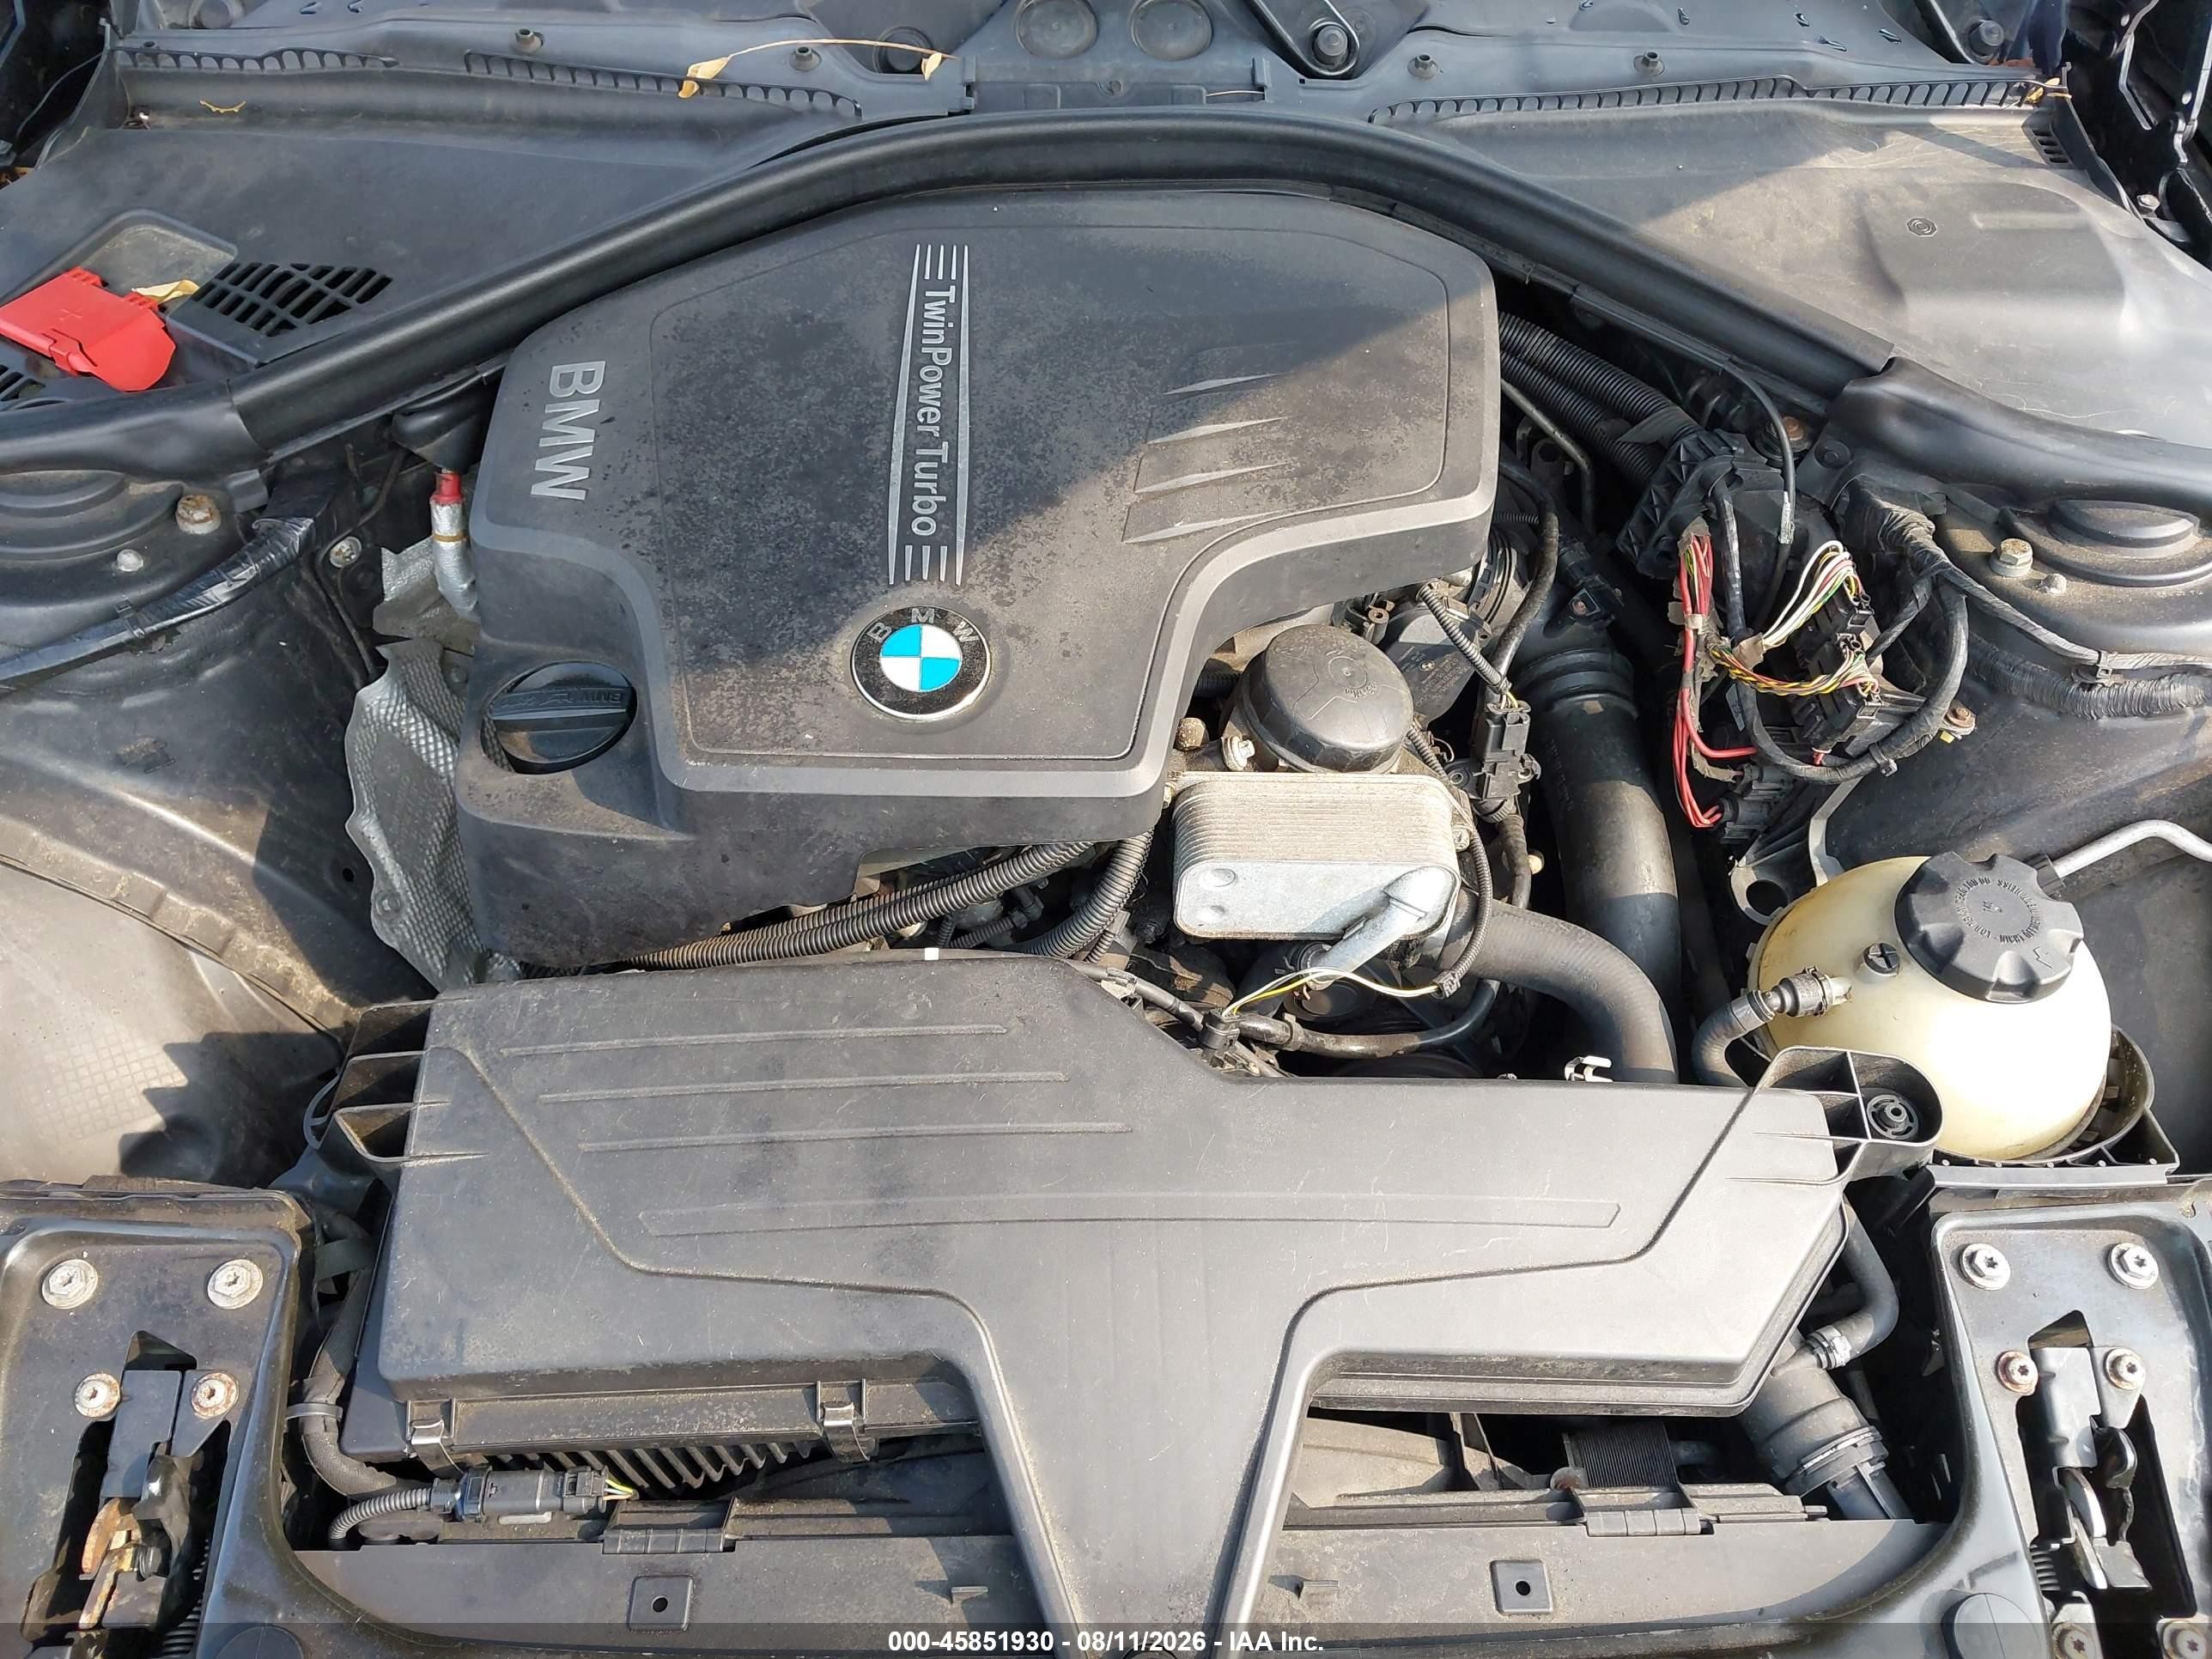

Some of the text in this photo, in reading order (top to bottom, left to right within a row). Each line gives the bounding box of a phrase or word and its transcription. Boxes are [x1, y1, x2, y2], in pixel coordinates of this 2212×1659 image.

[531, 361, 606, 501] BMW
[911, 284, 956, 537] TwinPower Turbo
[866, 607, 979, 643] BMW
